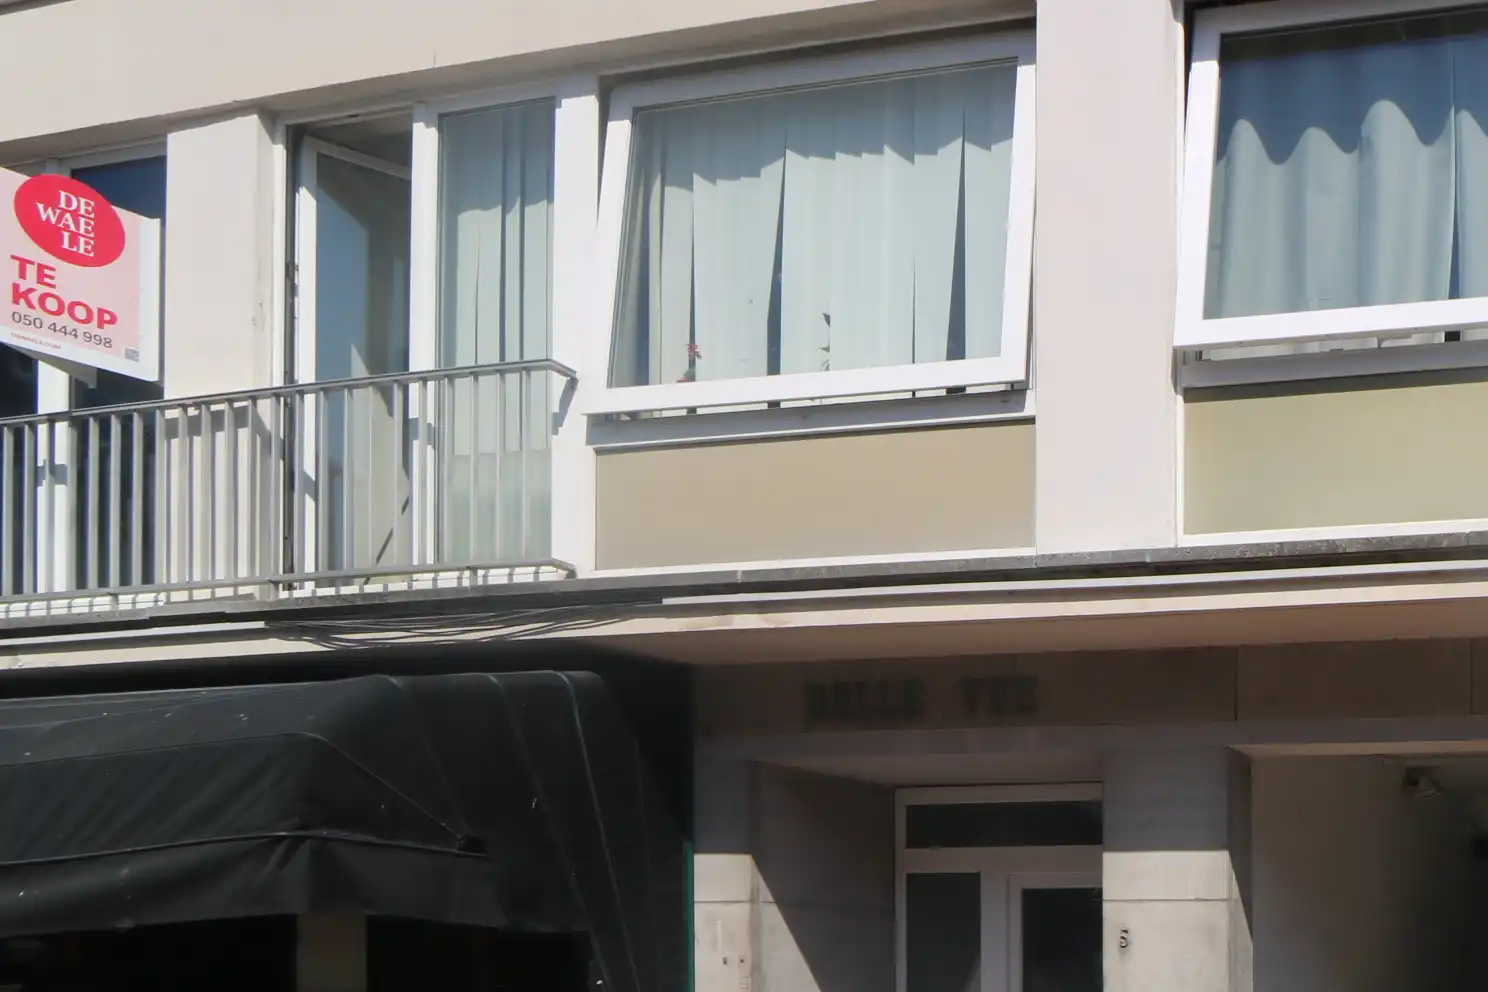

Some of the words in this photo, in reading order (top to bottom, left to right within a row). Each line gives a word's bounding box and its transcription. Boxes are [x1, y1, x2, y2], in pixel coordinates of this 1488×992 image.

[36, 202, 95, 238] WAE
[58, 190, 95, 218] DE
[61, 231, 95, 257] LE
[10, 254, 57, 289] TE
[11, 282, 118, 330] KOOP
[12, 311, 43, 330] 050
[47, 321, 79, 340] 444
[83, 331, 113, 349] 998
